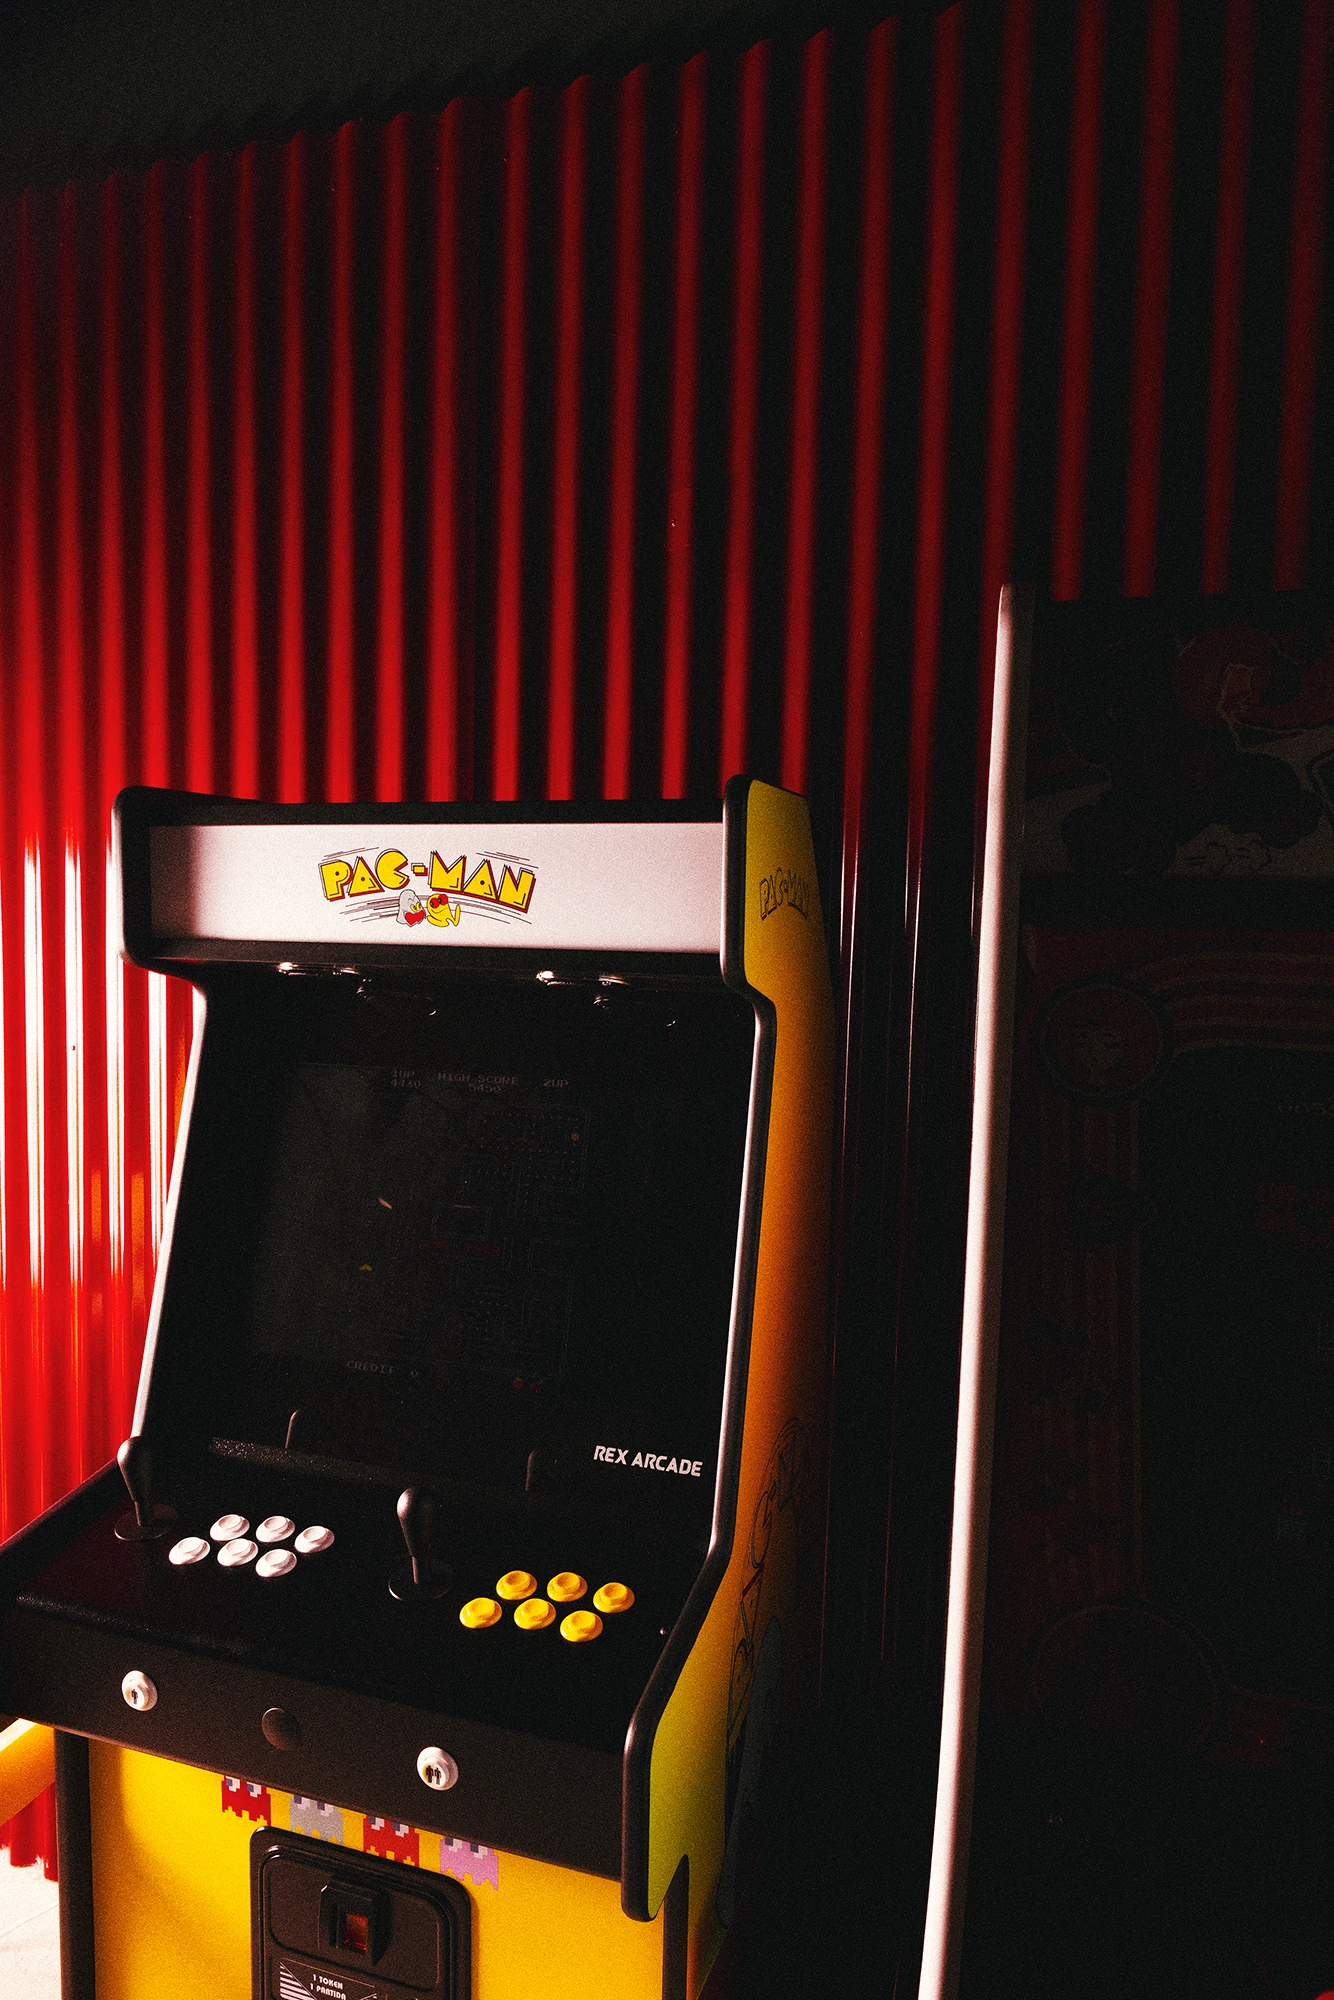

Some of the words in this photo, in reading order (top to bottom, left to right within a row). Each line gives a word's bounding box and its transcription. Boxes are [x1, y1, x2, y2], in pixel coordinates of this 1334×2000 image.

[318, 847, 537, 914] PAC-MAN
[437, 1072, 470, 1082] HIGH
[478, 1074, 519, 1086] SCORE
[542, 1078, 569, 1088] 2UP
[345, 1360, 394, 1376] CREDIT
[593, 1444, 629, 1465] REX
[631, 1451, 703, 1477] ARCADE
[312, 1973, 317, 1982] 1
[318, 1975, 343, 1990] TOKEN
[309, 1982, 314, 1990] 1
[316, 1985, 347, 2000] PARTIDA
